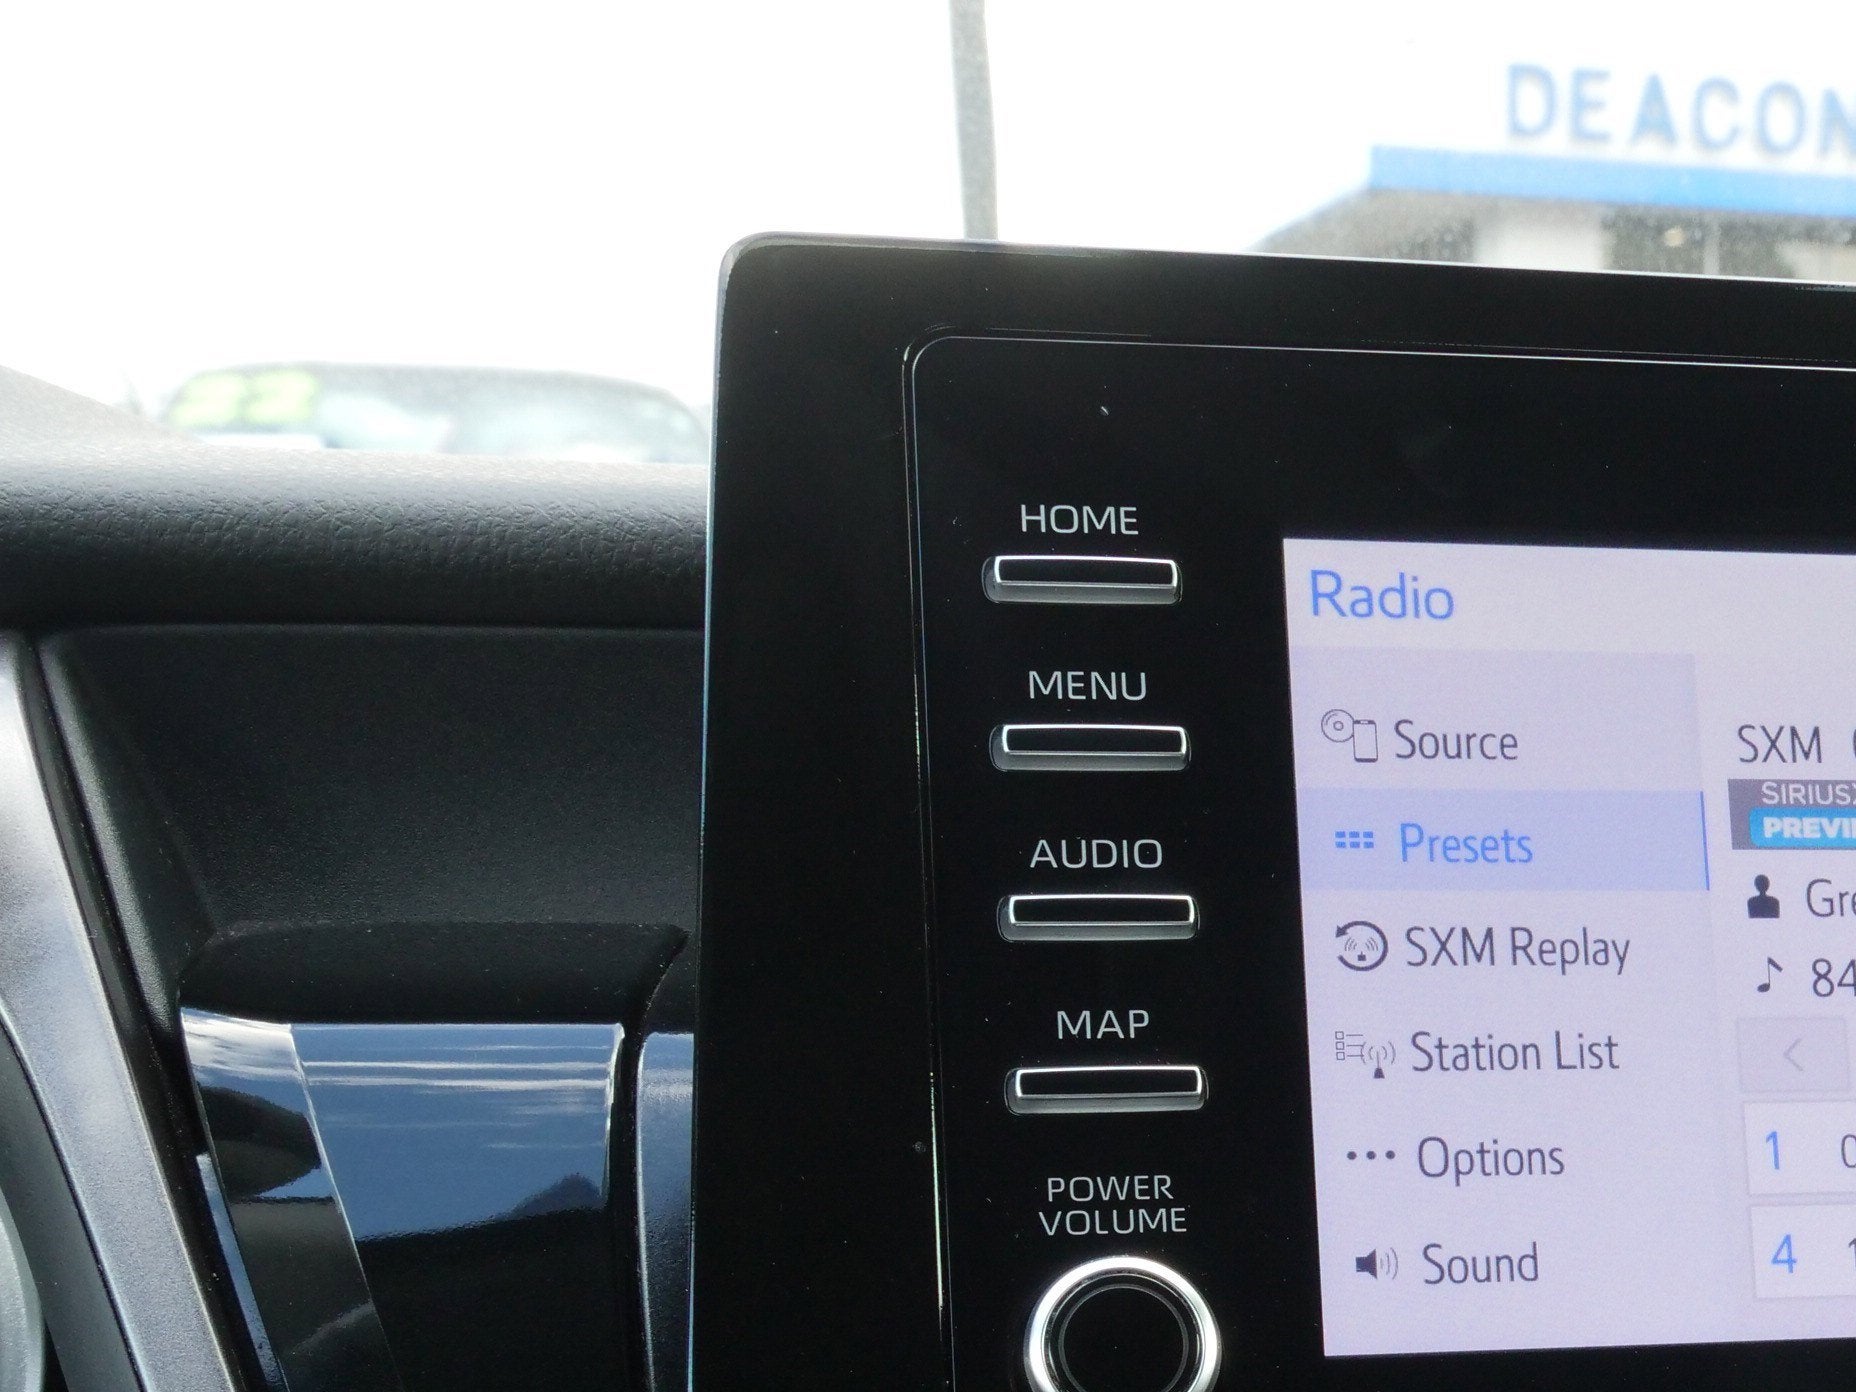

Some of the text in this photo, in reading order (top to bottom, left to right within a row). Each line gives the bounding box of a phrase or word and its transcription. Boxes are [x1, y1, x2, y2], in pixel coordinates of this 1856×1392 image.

[1020, 504, 1139, 534] HOME
[1310, 569, 1456, 621] Radio
[1029, 671, 1147, 700] MENU
[1394, 719, 1520, 760] Source
[1737, 724, 1823, 764] SXM
[1030, 839, 1163, 868] AUDIO
[1399, 823, 1534, 864] Presets
[1405, 926, 1630, 976] SXM Replay
[1057, 1009, 1150, 1040] MAP
[1411, 1030, 1620, 1072] Station List
[1417, 1136, 1565, 1187] Options
[1765, 1130, 1781, 1170] 1
[1047, 1174, 1173, 1202] POWER
[1038, 1207, 1187, 1236] VOLUME
[1422, 1241, 1539, 1285] Sound
[1771, 1233, 1798, 1274] 4
